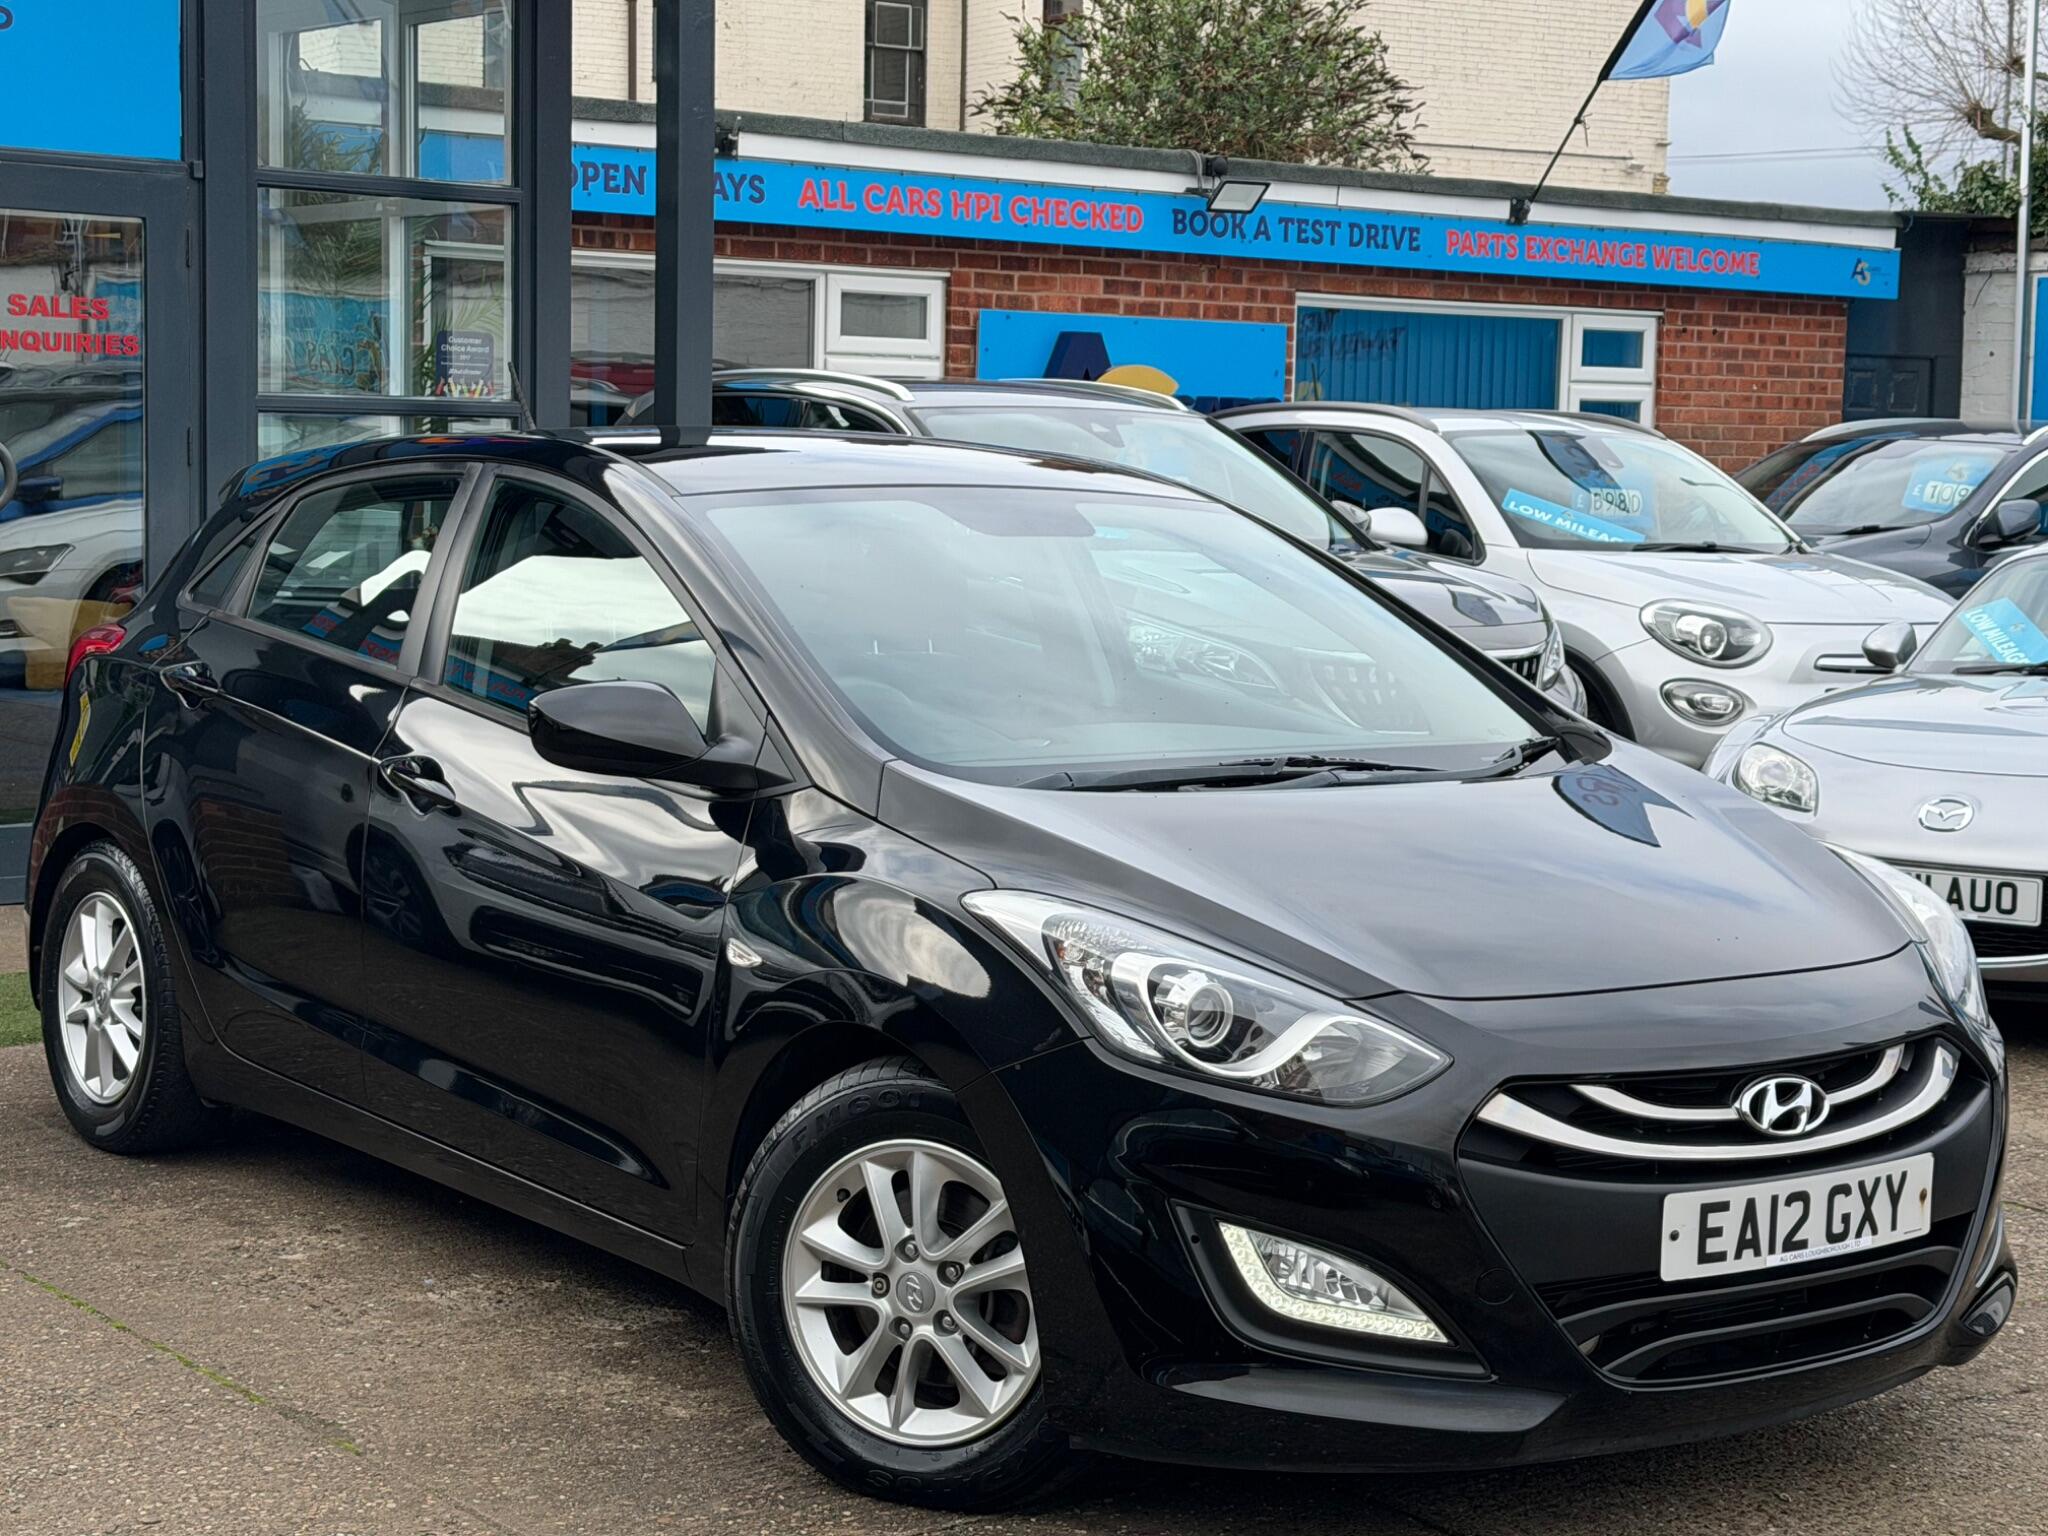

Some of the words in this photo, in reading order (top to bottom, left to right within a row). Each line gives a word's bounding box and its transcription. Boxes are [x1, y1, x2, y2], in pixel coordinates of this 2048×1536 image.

[714, 171, 766, 204] AYS
[798, 178, 855, 212] ALL
[863, 184, 943, 218] CARS
[950, 190, 1003, 223] HPI
[1009, 195, 1145, 233] CHECKED
[1171, 207, 1247, 240] BOOK
[1253, 215, 1272, 242] A
[1278, 216, 1342, 247] TEST
[1347, 222, 1422, 252] DRIVE
[1445, 229, 1519, 260] PARTS
[1524, 236, 1648, 269] EXCHANGE
[1651, 245, 1761, 276] WELCOME
[7, 293, 110, 320] SALES
[0, 329, 140, 356] NQUIRIES
[1508, 500, 1551, 521] LOW
[1555, 517, 1625, 542] MILEAG
[1964, 608, 1997, 631] LOW
[1946, 876, 2018, 916] AUO
[1697, 1189, 1811, 1266] EA12
[1825, 1170, 1908, 1245] GXY
